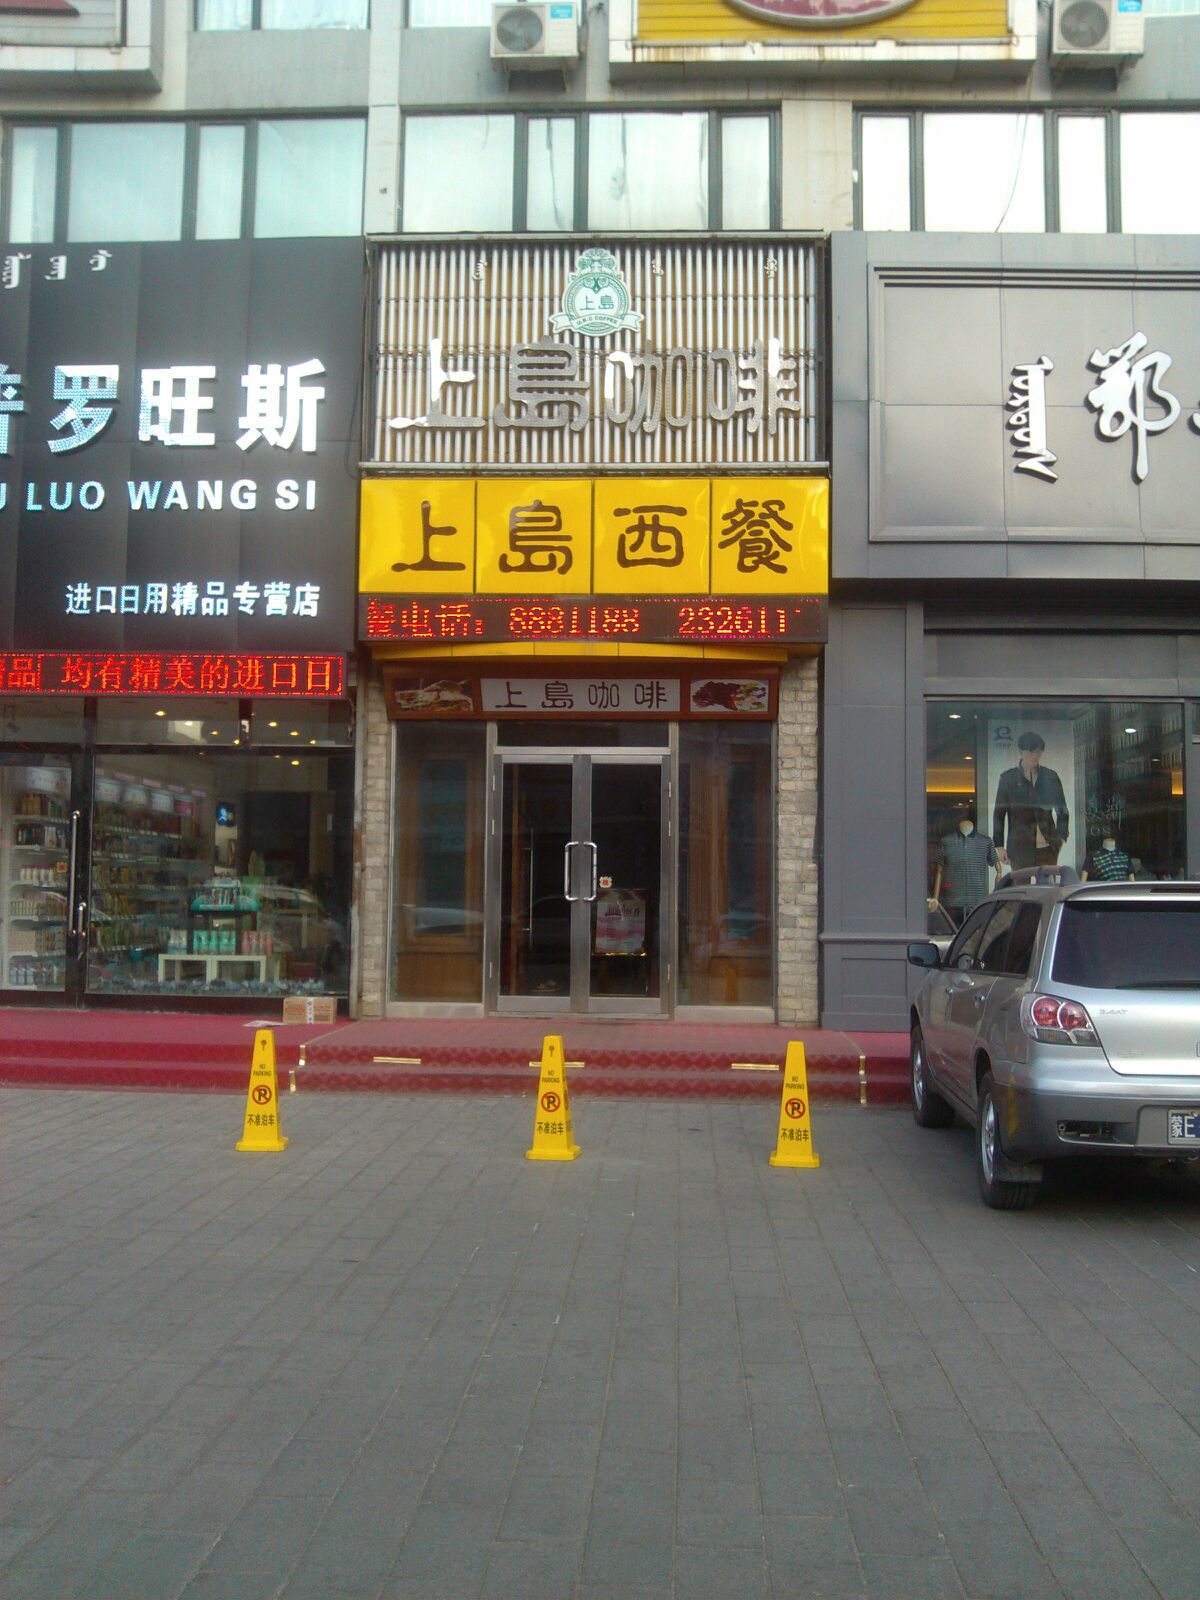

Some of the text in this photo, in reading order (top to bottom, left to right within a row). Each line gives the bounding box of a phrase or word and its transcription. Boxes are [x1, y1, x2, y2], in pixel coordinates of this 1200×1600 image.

[389, 335, 800, 435] 上島咖啡
[26, 480, 105, 511] LUO
[127, 479, 257, 511] WANG
[275, 479, 316, 511] SI
[391, 498, 794, 575] 上島西餐
[65, 581, 321, 617] 进口日用精品专营店
[509, 605, 640, 634] 8881188
[0, 656, 331, 690] 品 均有精美的进口日
[495, 681, 668, 710] 上島咖啡
[780, 1128, 809, 1142] 不准泊车
